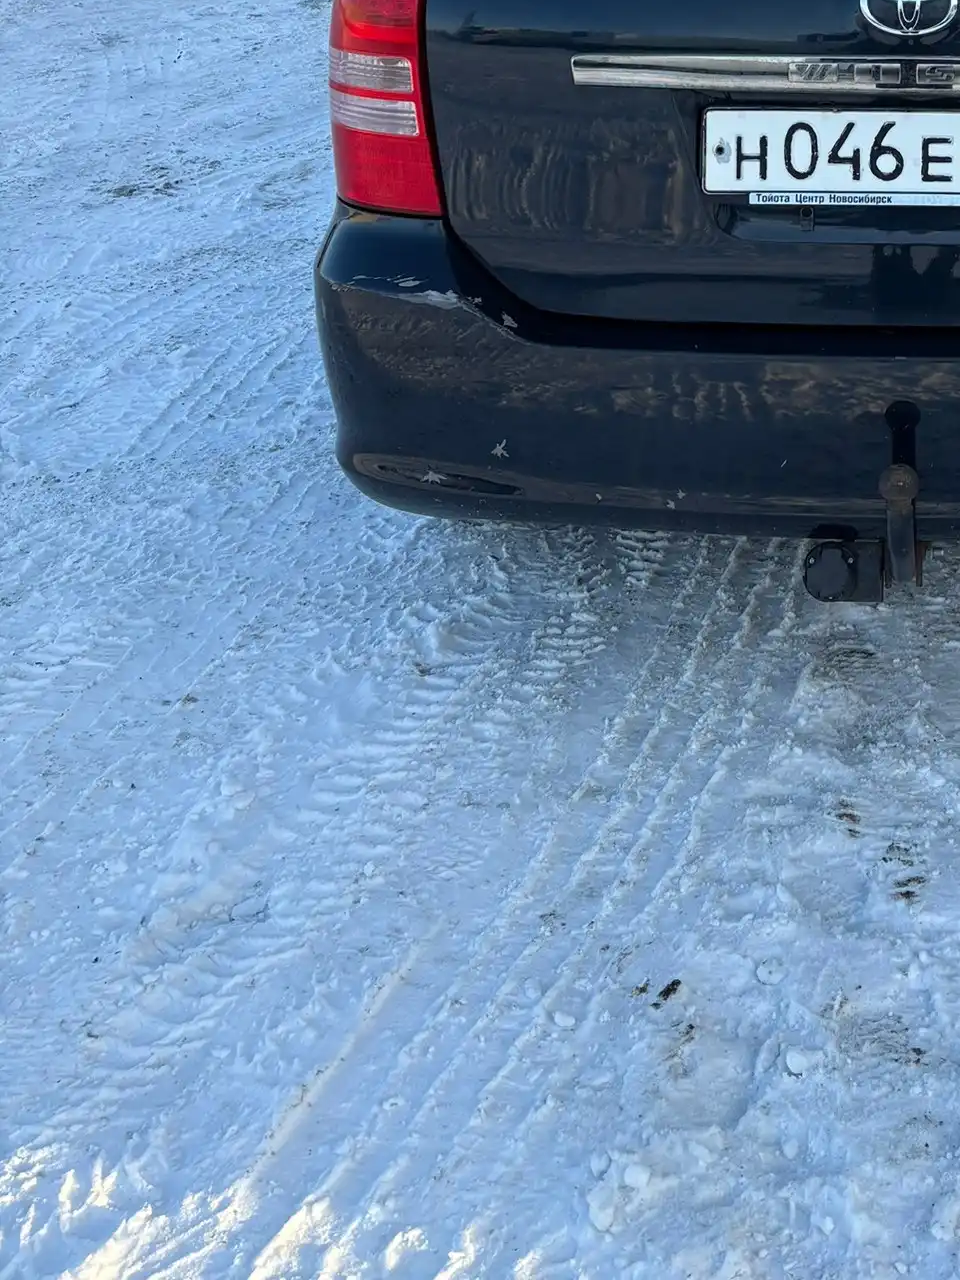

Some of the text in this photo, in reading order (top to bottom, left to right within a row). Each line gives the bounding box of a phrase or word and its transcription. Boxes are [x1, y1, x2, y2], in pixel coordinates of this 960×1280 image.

[756, 193, 892, 205] Тойота Центр Новосибирск
